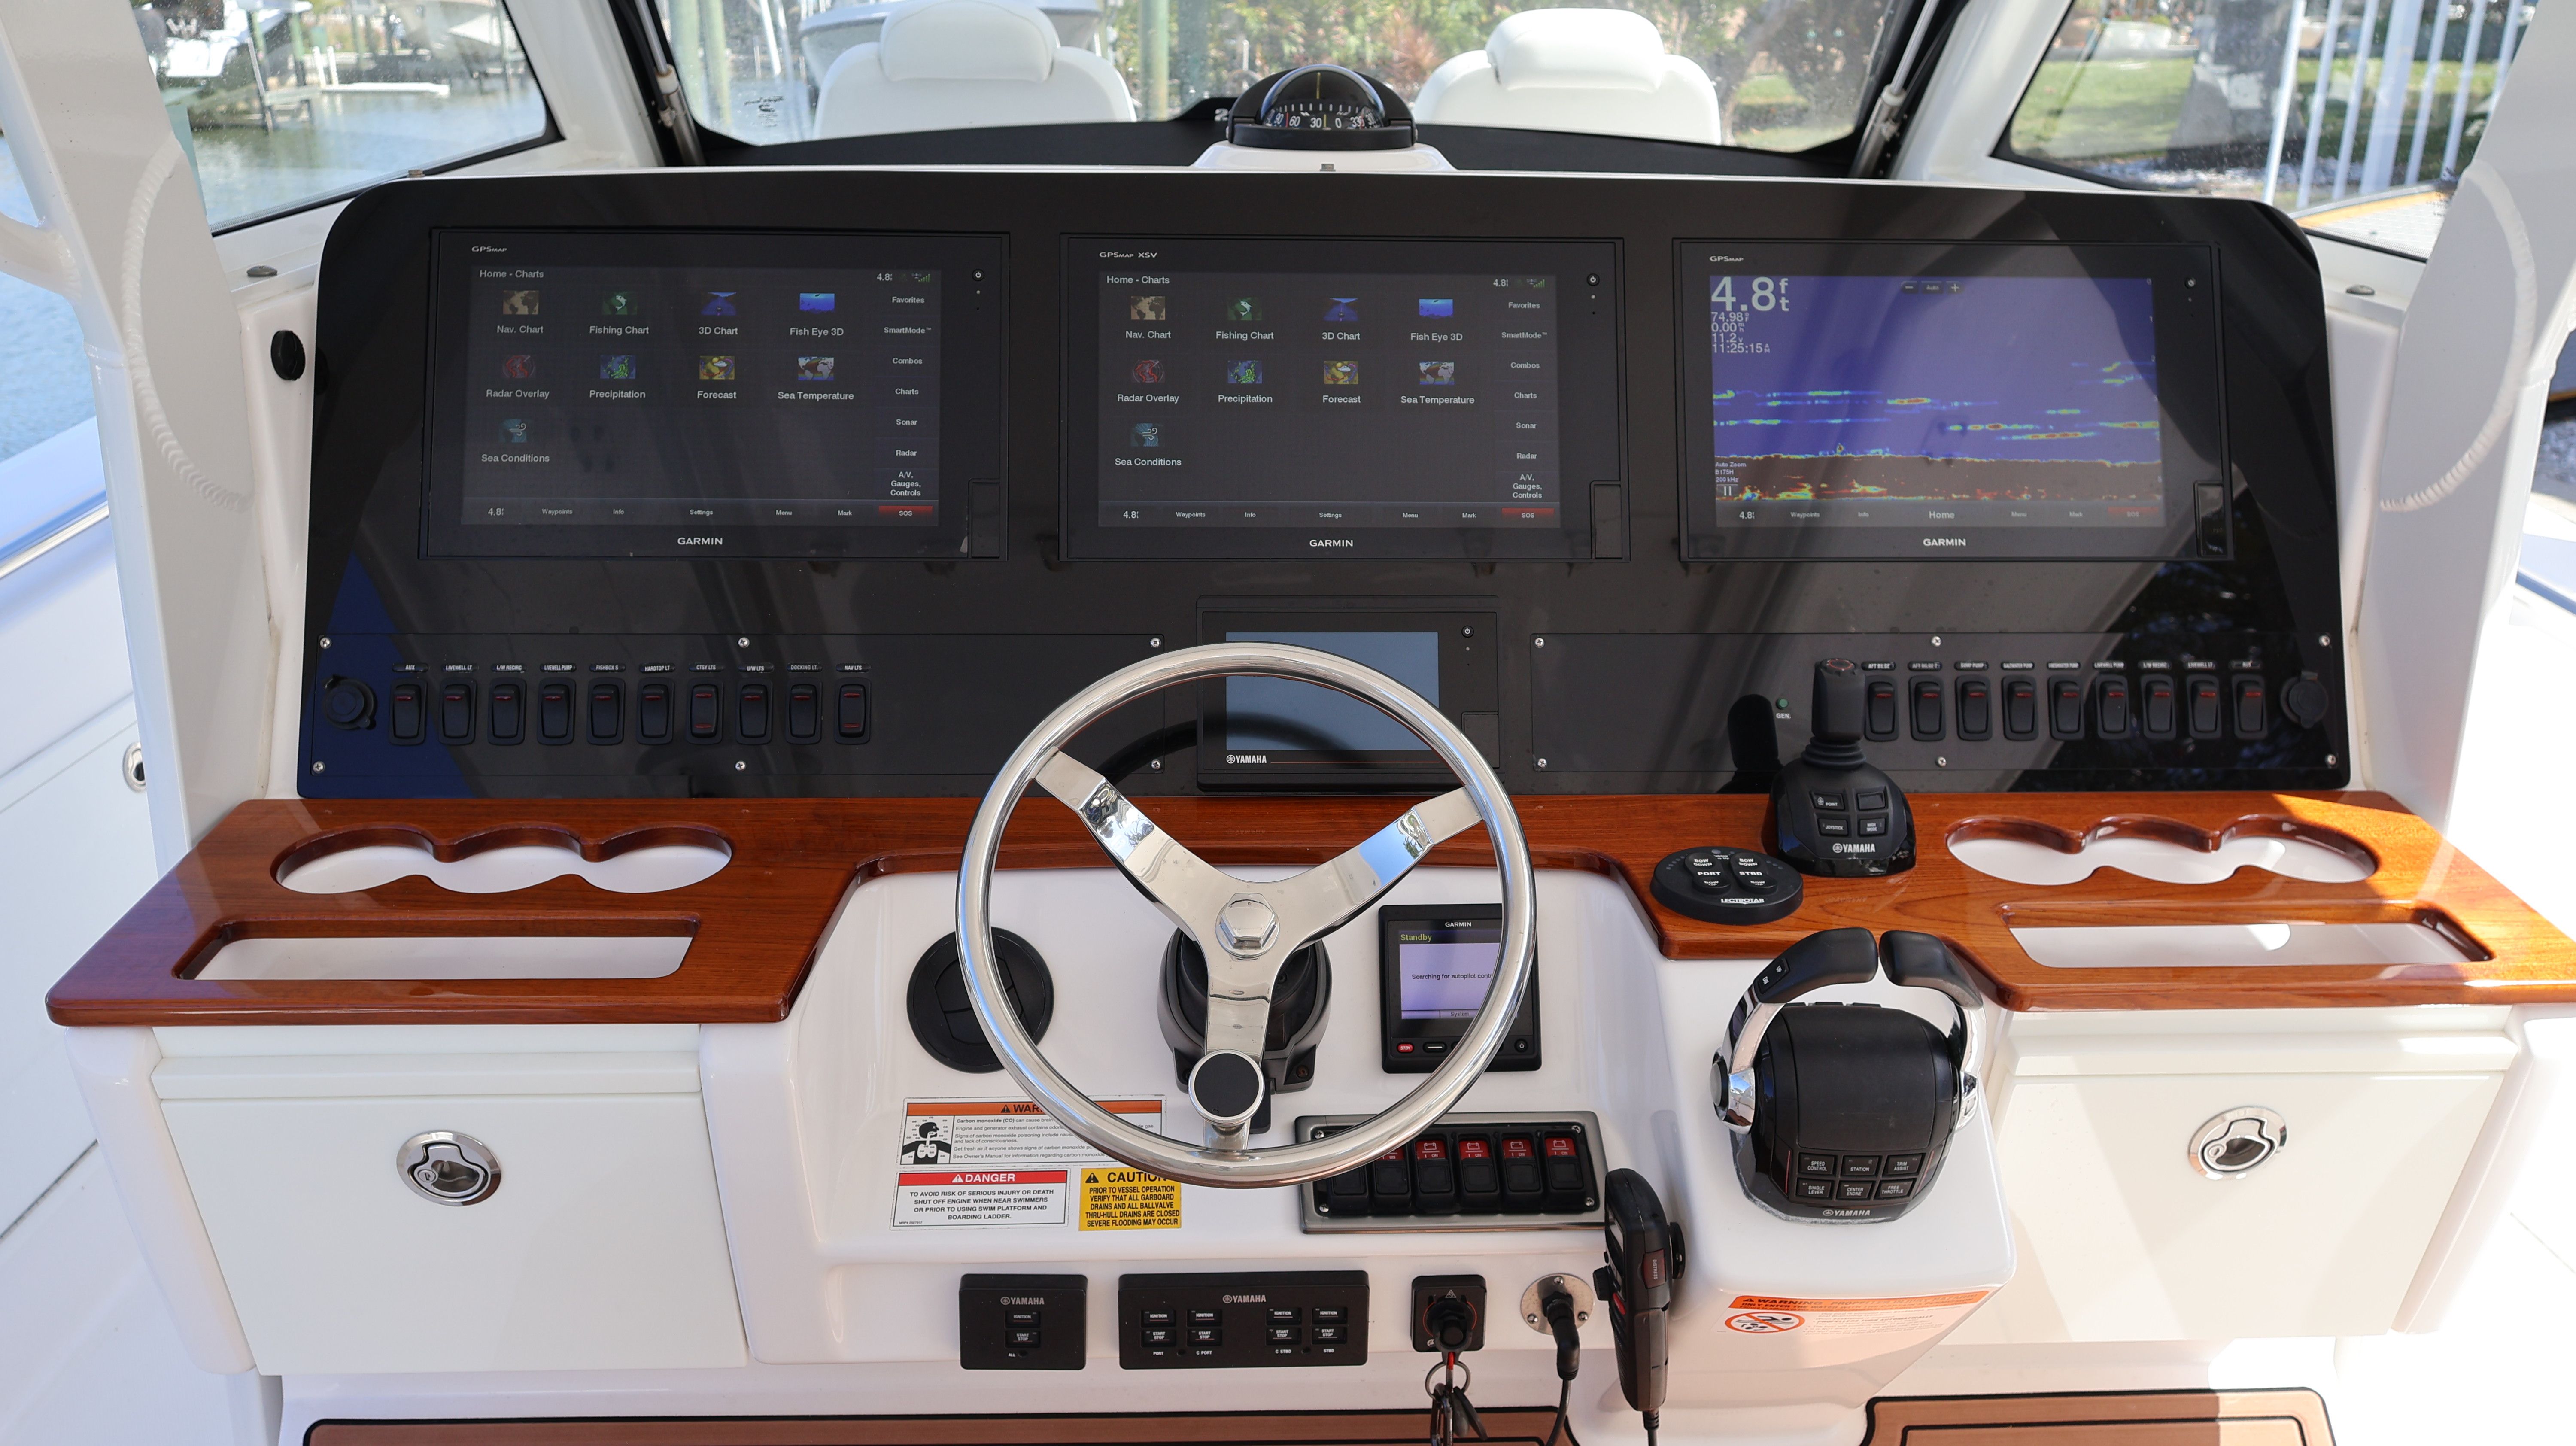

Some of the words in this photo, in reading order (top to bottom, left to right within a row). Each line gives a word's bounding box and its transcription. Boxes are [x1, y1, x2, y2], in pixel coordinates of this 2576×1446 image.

[1289, 115, 1301, 127] 60
[1310, 117, 1322, 128] 30
[1335, 118, 1342, 128] 0
[480, 270, 507, 278] Home
[515, 270, 544, 278] Charts
[1711, 276, 1776, 311] 4.8
[1711, 312, 1744, 322] 74.98
[497, 325, 516, 333] Nav.
[519, 325, 544, 334] Chart
[589, 325, 622, 336] Fishing
[625, 326, 649, 334] Chart
[699, 326, 711, 334] 3D
[714, 327, 738, 335] Chart
[790, 327, 809, 335] Fish
[811, 328, 829, 337] Eye
[1711, 322, 1737, 332] 0.00
[1147, 331, 1171, 339] Chart
[1216, 331, 1248, 341] Fishing
[1322, 332, 1334, 340] 3D
[1432, 333, 1448, 343] Eye
[1450, 333, 1463, 341] 3D
[1712, 332, 1737, 343] 11.2
[1712, 343, 1763, 353] 11:25:15
[486, 389, 513, 397] Radar
[515, 389, 550, 400] Overlay
[589, 390, 646, 400] Precipitation
[697, 391, 737, 399] Forecast
[778, 391, 796, 399] Sea
[797, 391, 854, 401] Temperature
[1118, 394, 1144, 402] Radar
[1145, 394, 1179, 404] Overlay
[1218, 395, 1273, 404] Precipitation
[1323, 395, 1361, 403] Forecast
[1419, 395, 1475, 406] Temperature
[481, 454, 499, 462] Sea
[501, 454, 550, 462] Conditions
[1134, 458, 1182, 466] Conditions
[891, 480, 921, 489] Gauges,
[1929, 511, 1955, 519] Home
[1236, 755, 1267, 763] YAMAHA
[1843, 843, 1875, 853] YAMAHA
[1400, 933, 1432, 942] Standby
[965, 1173, 1015, 1182] DANGER
[1010, 1297, 1045, 1305] YAMAHA
[1232, 1294, 1266, 1303] YAMAHA
